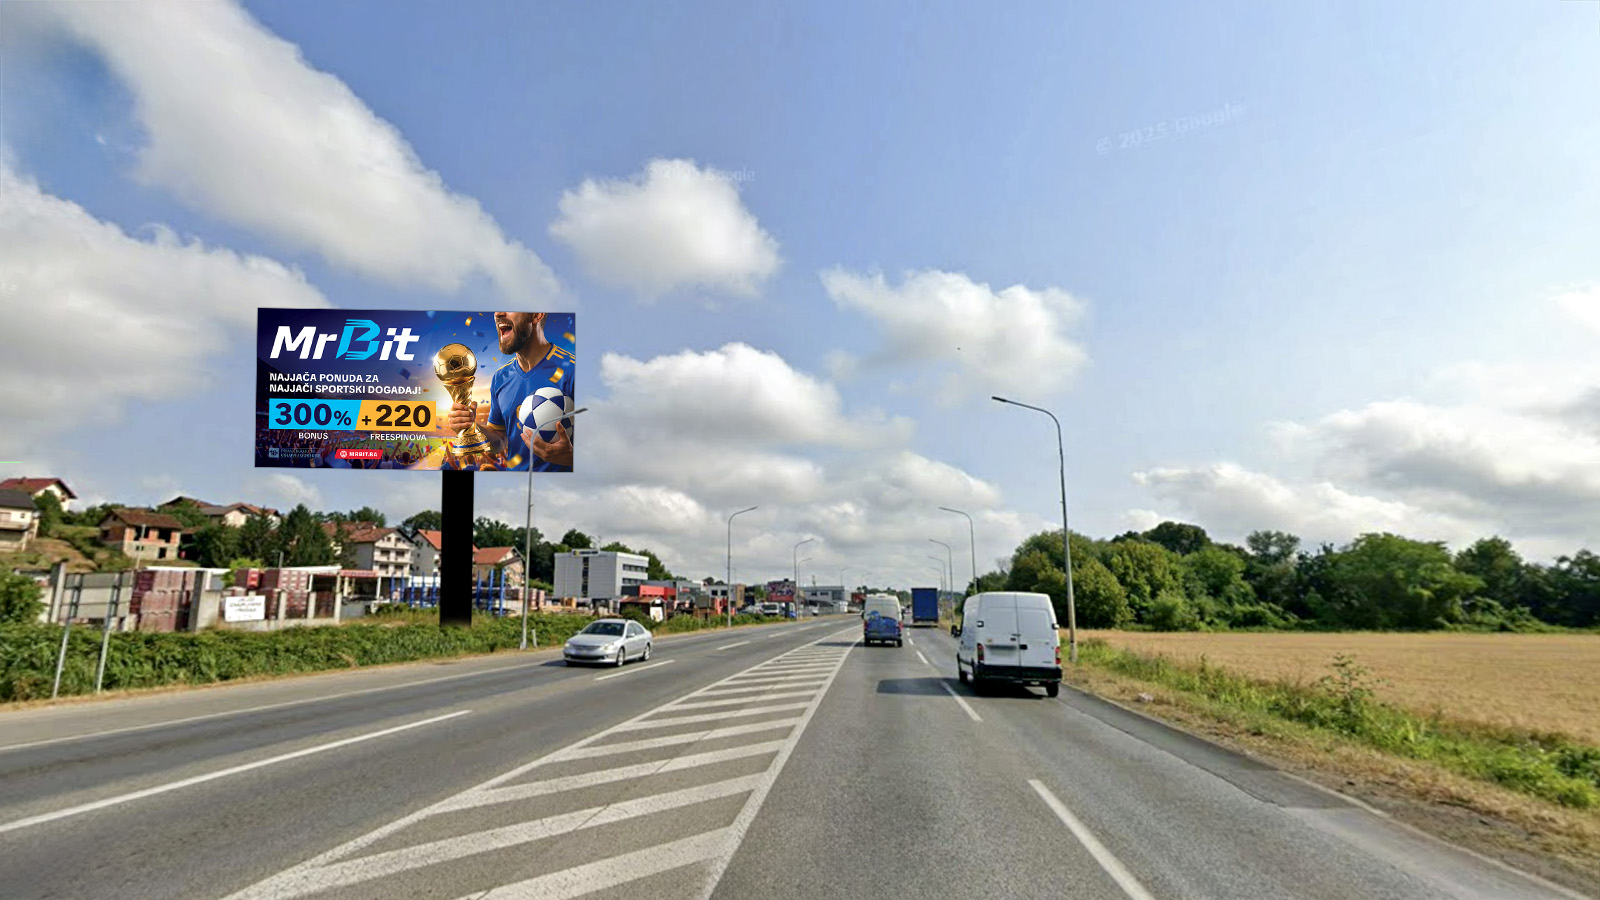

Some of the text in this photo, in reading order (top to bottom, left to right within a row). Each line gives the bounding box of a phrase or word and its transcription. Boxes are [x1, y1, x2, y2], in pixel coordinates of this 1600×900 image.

[270, 319, 419, 361] MrBit
[269, 371, 379, 383] NAJJAČA PONUDA ZA
[269, 383, 313, 393] NAJJAČI
[315, 384, 365, 394] SPORTSKI
[274, 402, 352, 426] 300%
[298, 432, 329, 440] BONUS
[370, 433, 427, 442] FREESPINOVA
